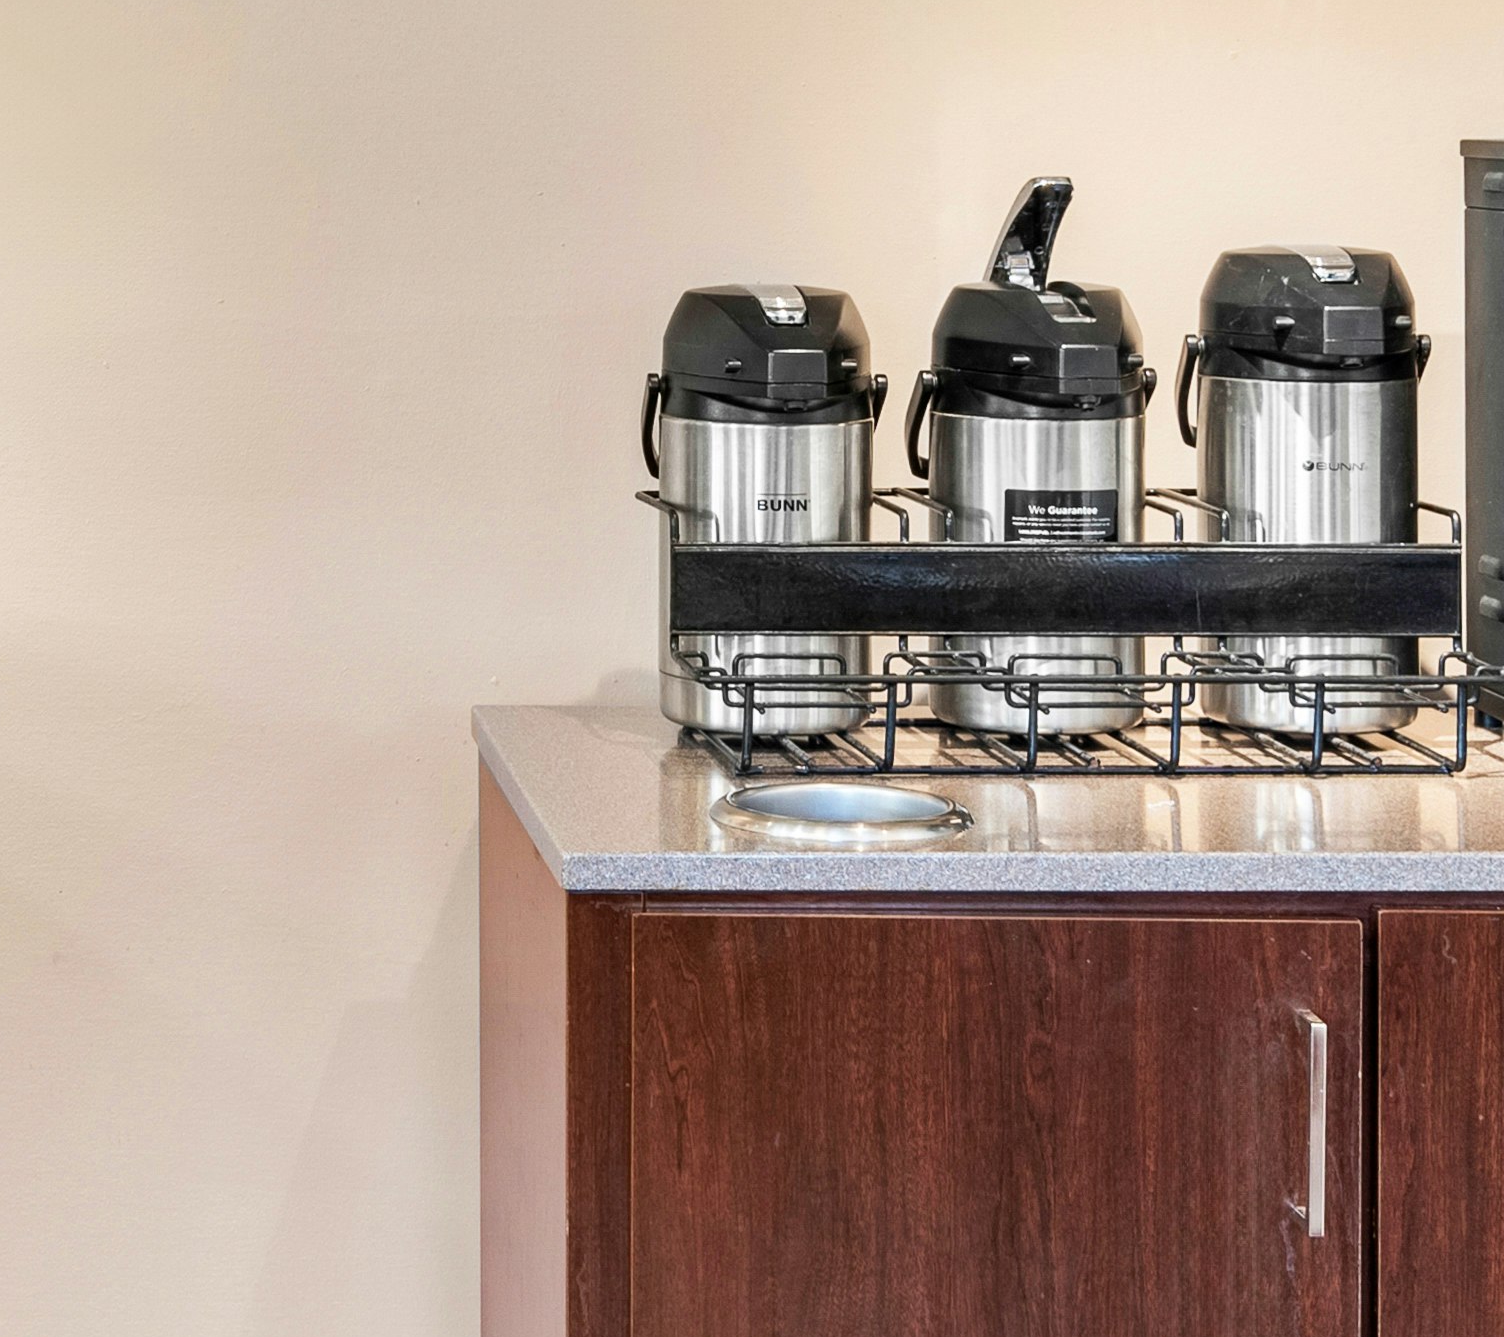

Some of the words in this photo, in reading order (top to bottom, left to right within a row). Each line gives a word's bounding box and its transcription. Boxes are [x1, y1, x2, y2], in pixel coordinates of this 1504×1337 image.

[1316, 462, 1366, 471] BUNN
[757, 499, 807, 511] BUNN
[1028, 505, 1046, 515] We
[1047, 505, 1099, 515] Guarantee
